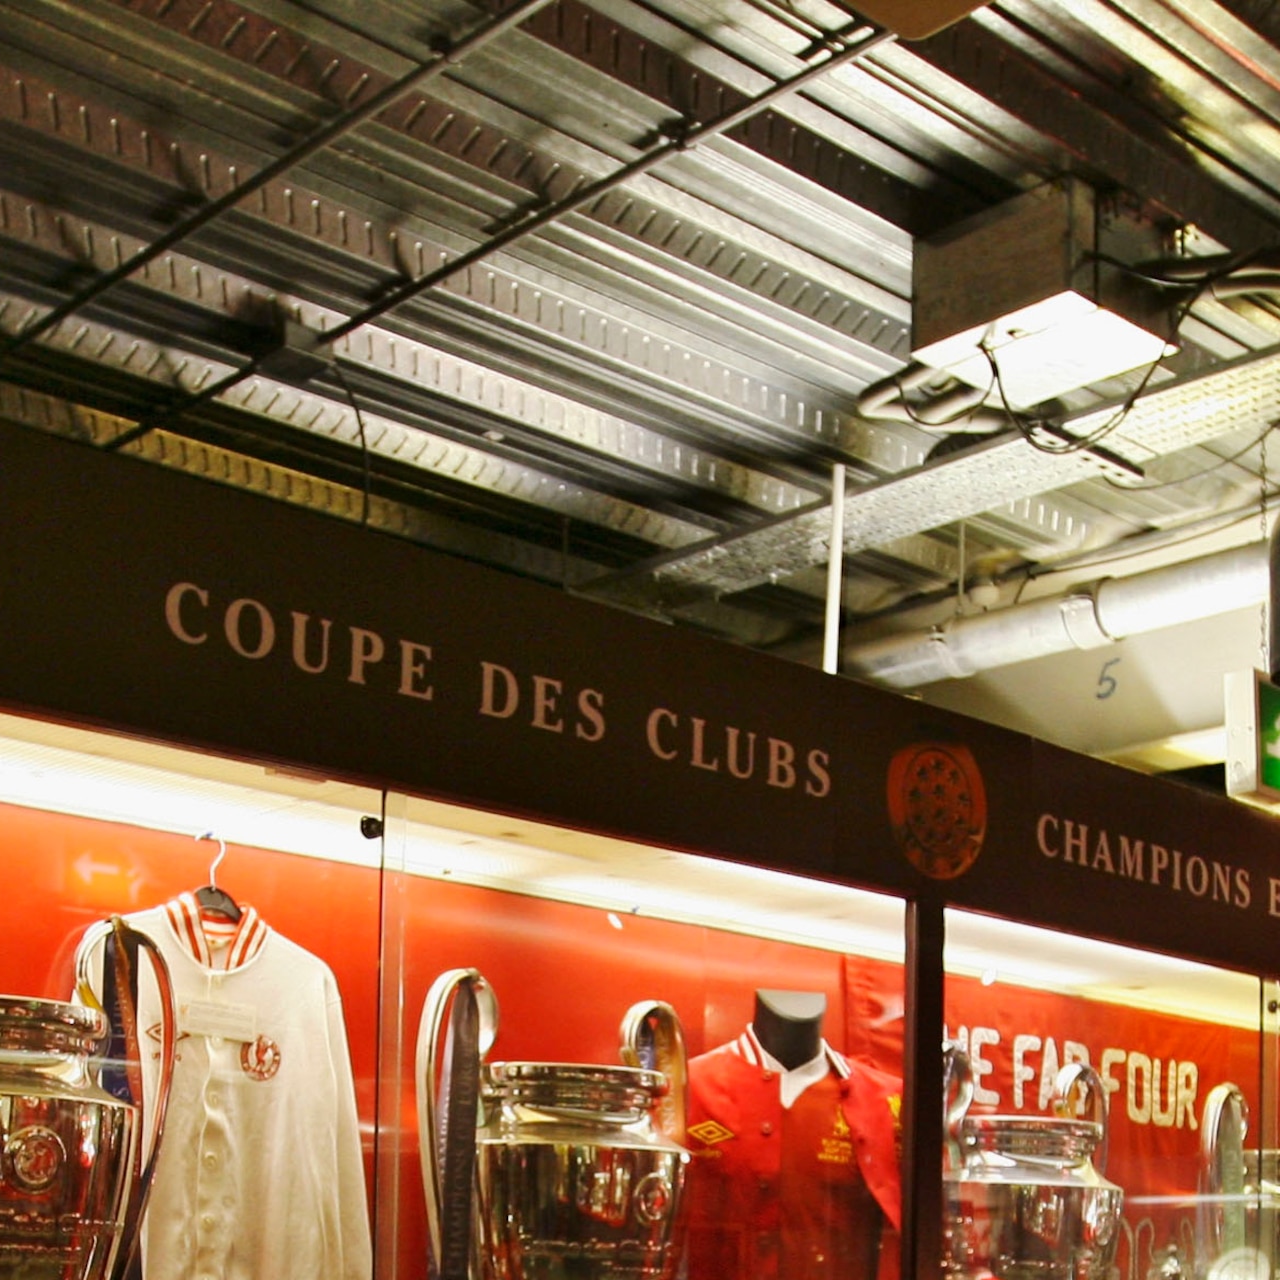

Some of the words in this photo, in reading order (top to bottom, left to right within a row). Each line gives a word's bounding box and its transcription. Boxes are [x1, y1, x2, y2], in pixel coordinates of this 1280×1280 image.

[165, 581, 433, 700] COUPE
[479, 661, 605, 742] DES
[646, 707, 832, 798] CLUBS
[1096, 657, 1121, 699] 5
[1037, 813, 1251, 910] CHAMPIONS
[1100, 1047, 1198, 1131] FOUR
